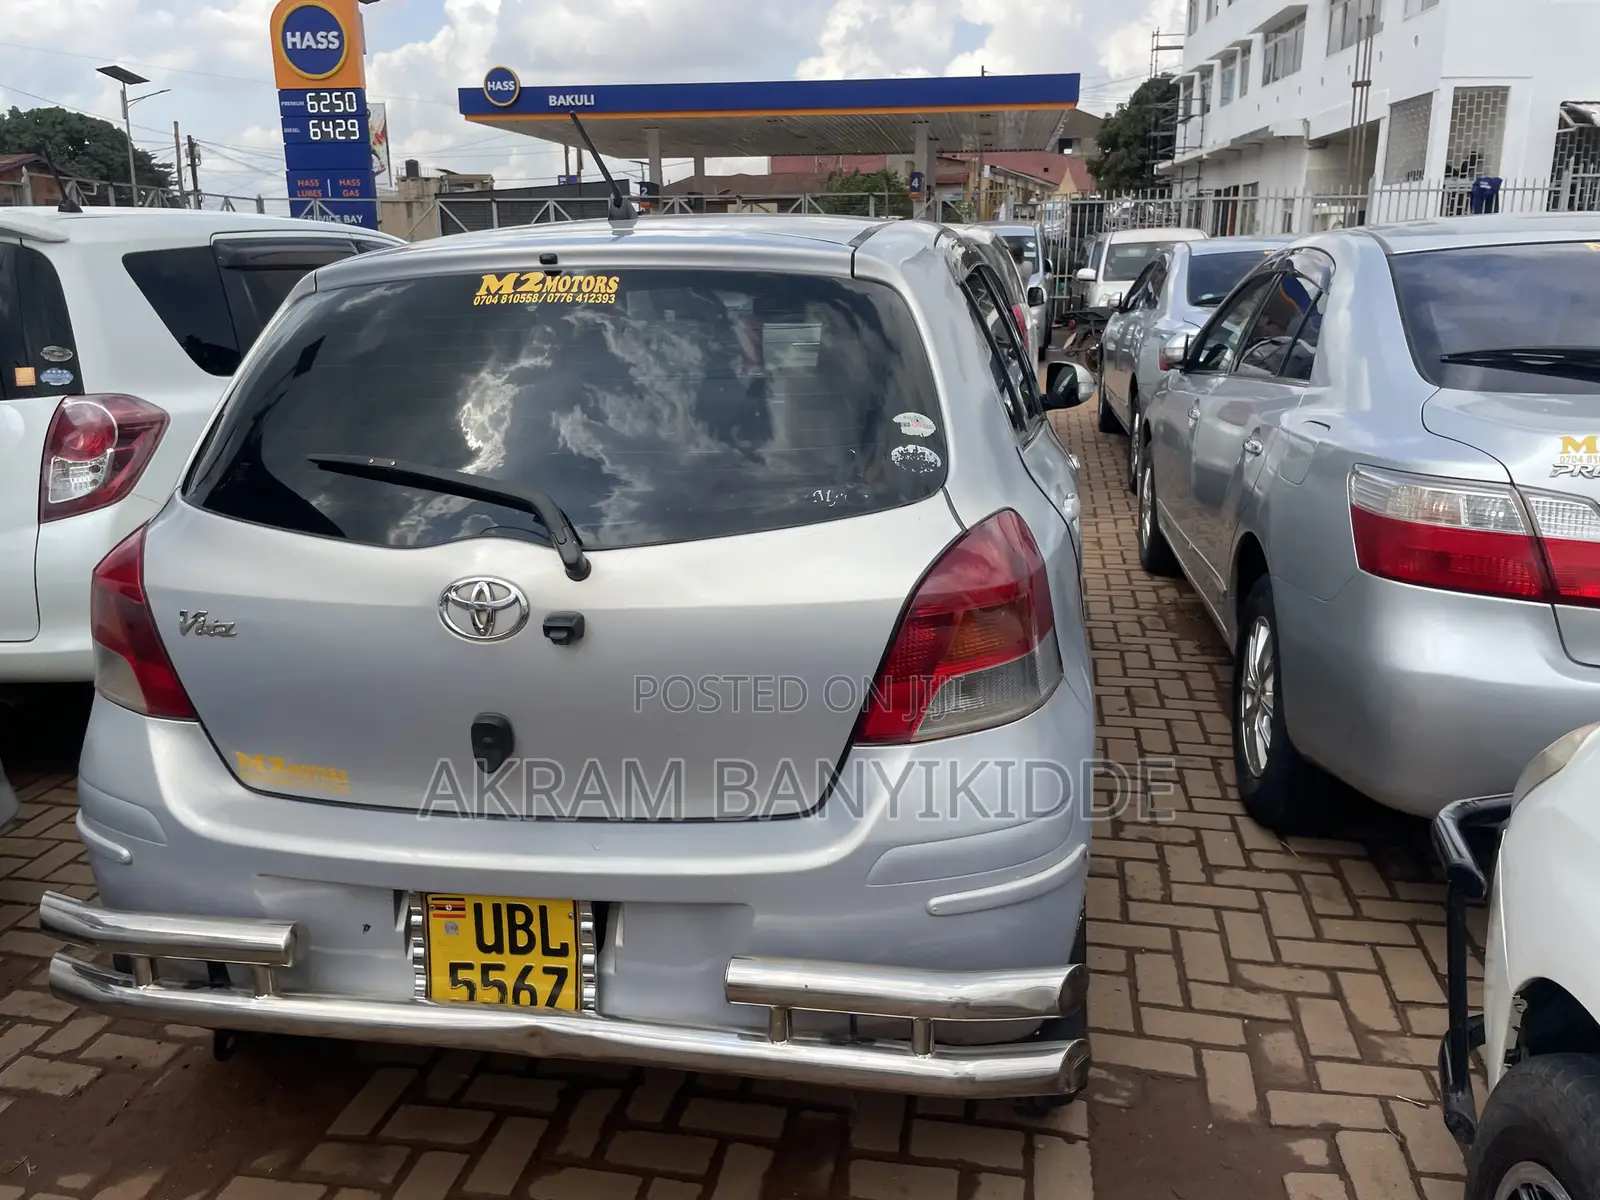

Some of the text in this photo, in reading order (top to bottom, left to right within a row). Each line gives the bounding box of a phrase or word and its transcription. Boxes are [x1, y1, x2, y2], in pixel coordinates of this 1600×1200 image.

[286, 31, 340, 50] HASS
[487, 80, 515, 91] HASS
[306, 92, 357, 113] 6250
[548, 94, 595, 106] BAKULI
[309, 119, 360, 140] 6429
[297, 179, 319, 187] HASS
[339, 179, 361, 187] HASS
[911, 178, 919, 188] 4
[641, 187, 648, 196] 2
[343, 215, 363, 224] BAY
[476, 272, 620, 296] M2 MOTORS
[473, 295, 498, 306] 0704
[547, 293, 573, 304] 0776
[576, 294, 616, 304] 412393
[179, 609, 237, 637] Vitz
[473, 902, 570, 958] UBL
[449, 961, 569, 1008] 5567
